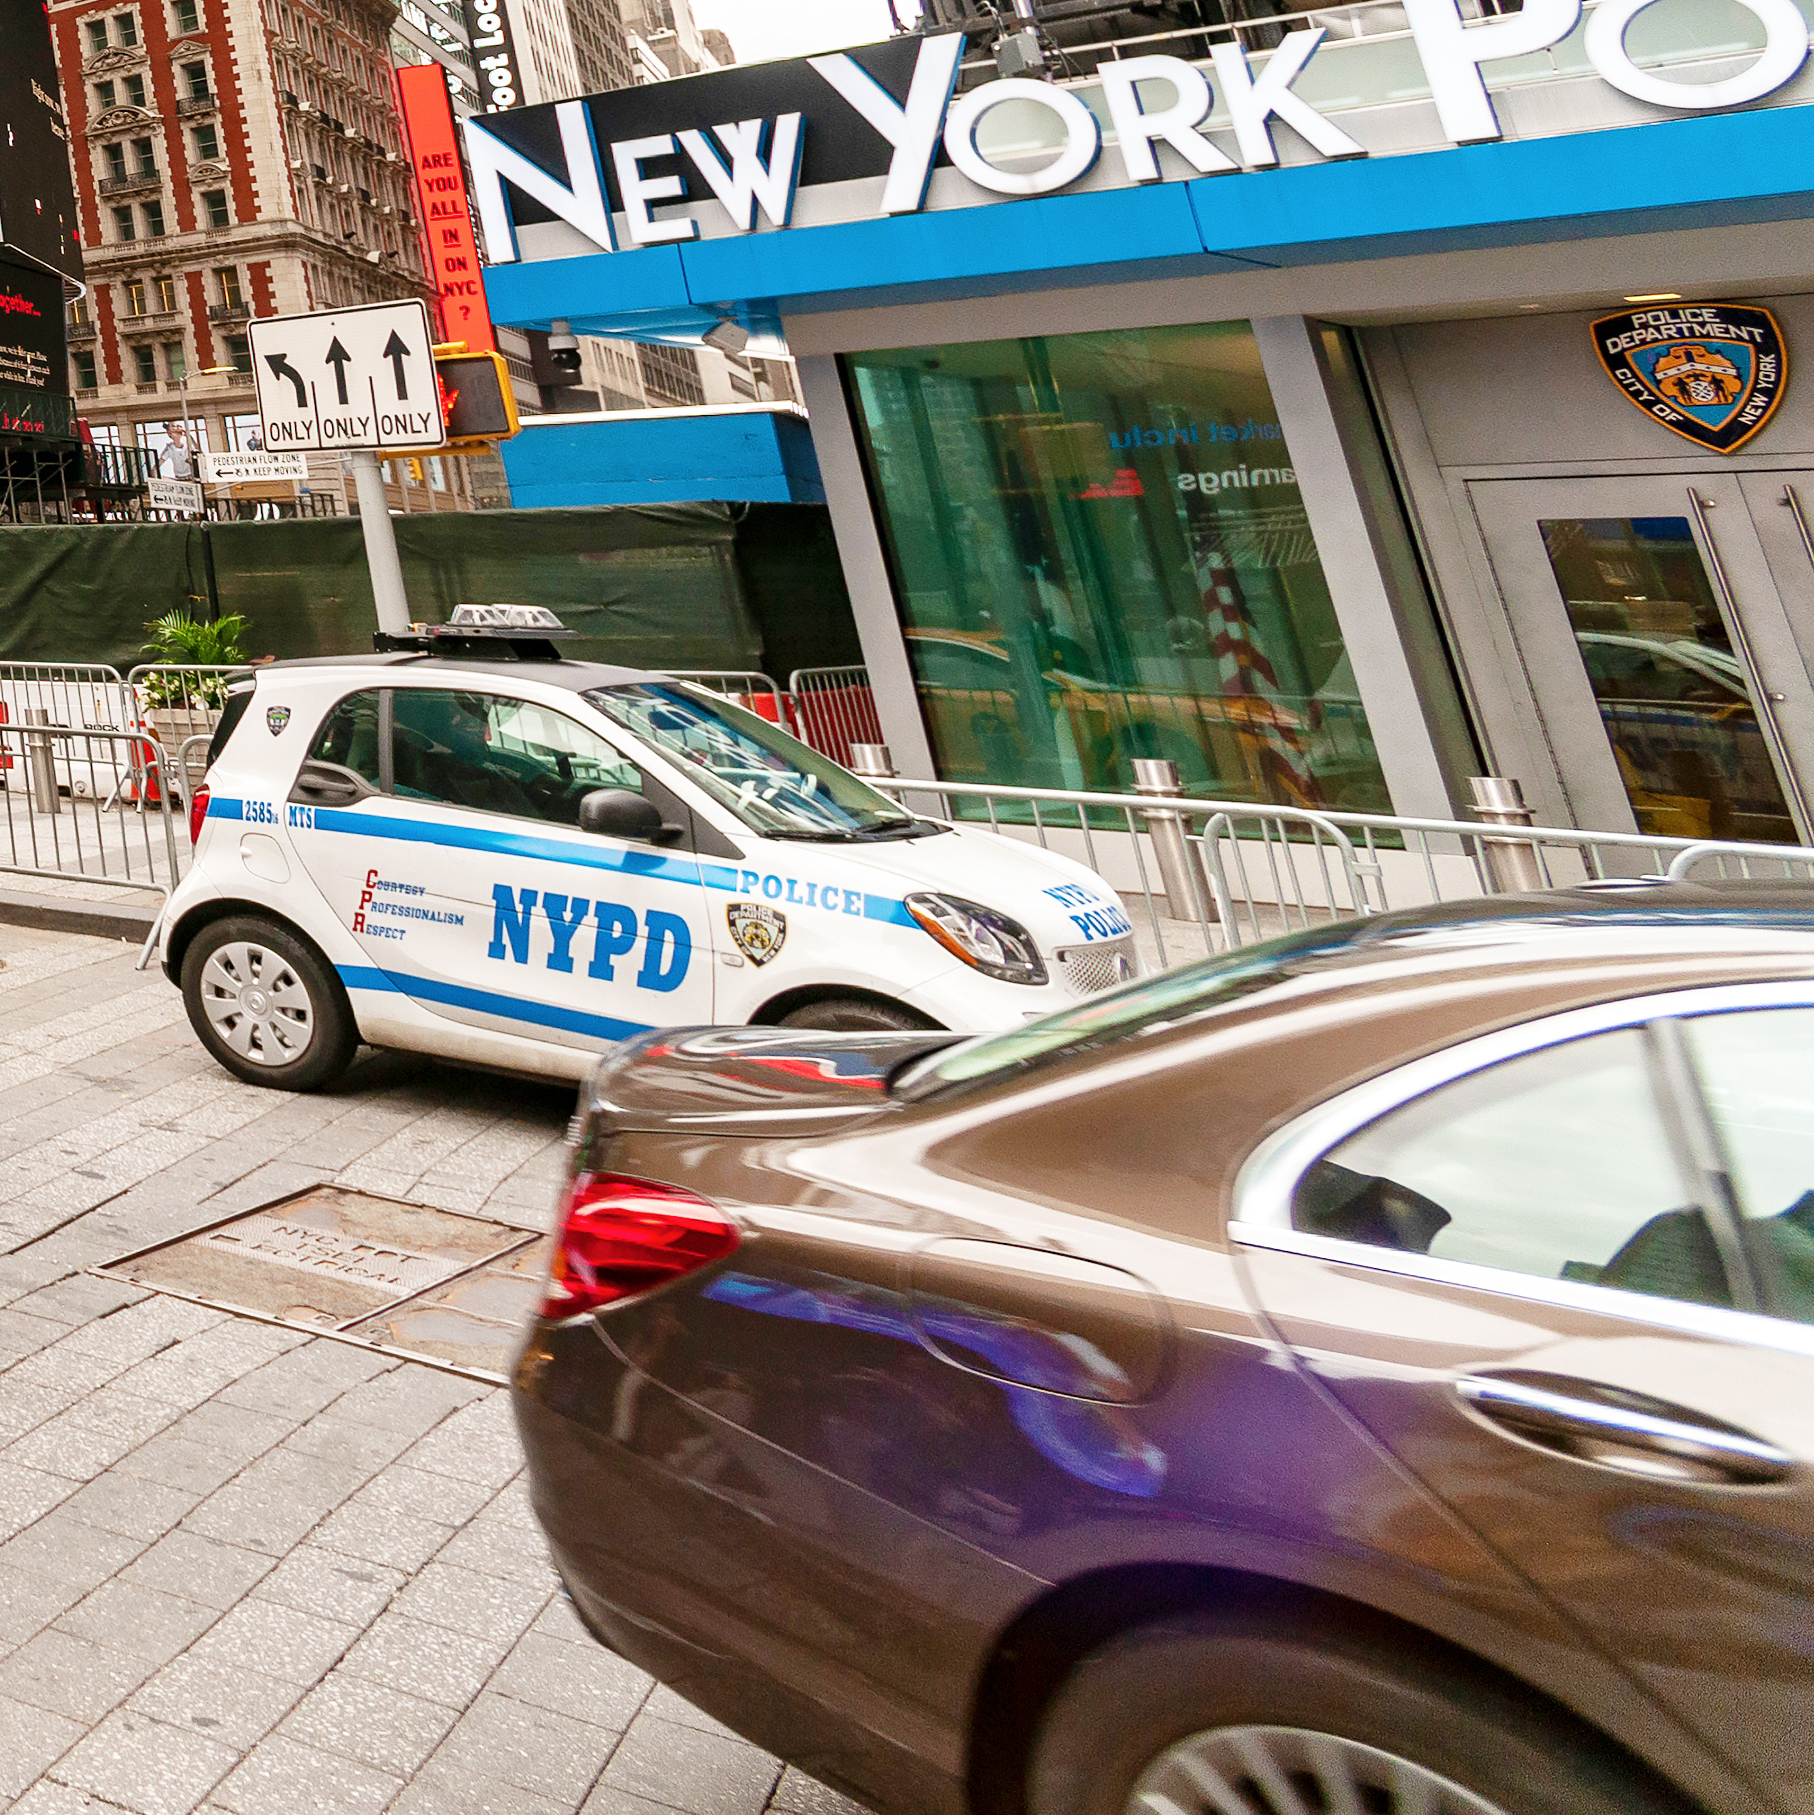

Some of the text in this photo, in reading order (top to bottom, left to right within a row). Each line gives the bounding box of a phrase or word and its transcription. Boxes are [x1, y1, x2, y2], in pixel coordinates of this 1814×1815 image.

[479, 53, 517, 114] oot
[463, 100, 807, 267] NEW
[806, 29, 1369, 217] YORK
[422, 152, 454, 170] ARE
[424, 175, 459, 193] YOU
[430, 199, 463, 217] ALL
[442, 228, 460, 244] IN
[445, 256, 468, 272] ON
[443, 280, 478, 296] NYC
[459, 305, 471, 320] ?
[1631, 308, 1720, 328] POLICE
[1606, 322, 1764, 354] DEPARTMENT
[1615, 368, 1684, 422] CITY OF
[1737, 354, 1776, 425] NEW YORK
[270, 420, 313, 442] ONLY
[323, 416, 370, 438] ONLY
[381, 412, 431, 436] ONLY
[212, 453, 302, 466] PEDESTRIAN FLOW ZONE
[253, 465, 304, 477] KEEP MOVING
[245, 799, 272, 824] 2585
[289, 805, 313, 829] MTS
[366, 869, 427, 896] COURTESY
[737, 868, 866, 917] POLICE
[358, 890, 465, 926] PROFESSIONALISM
[353, 913, 407, 941] RESPECT
[488, 884, 691, 992] NYPD
